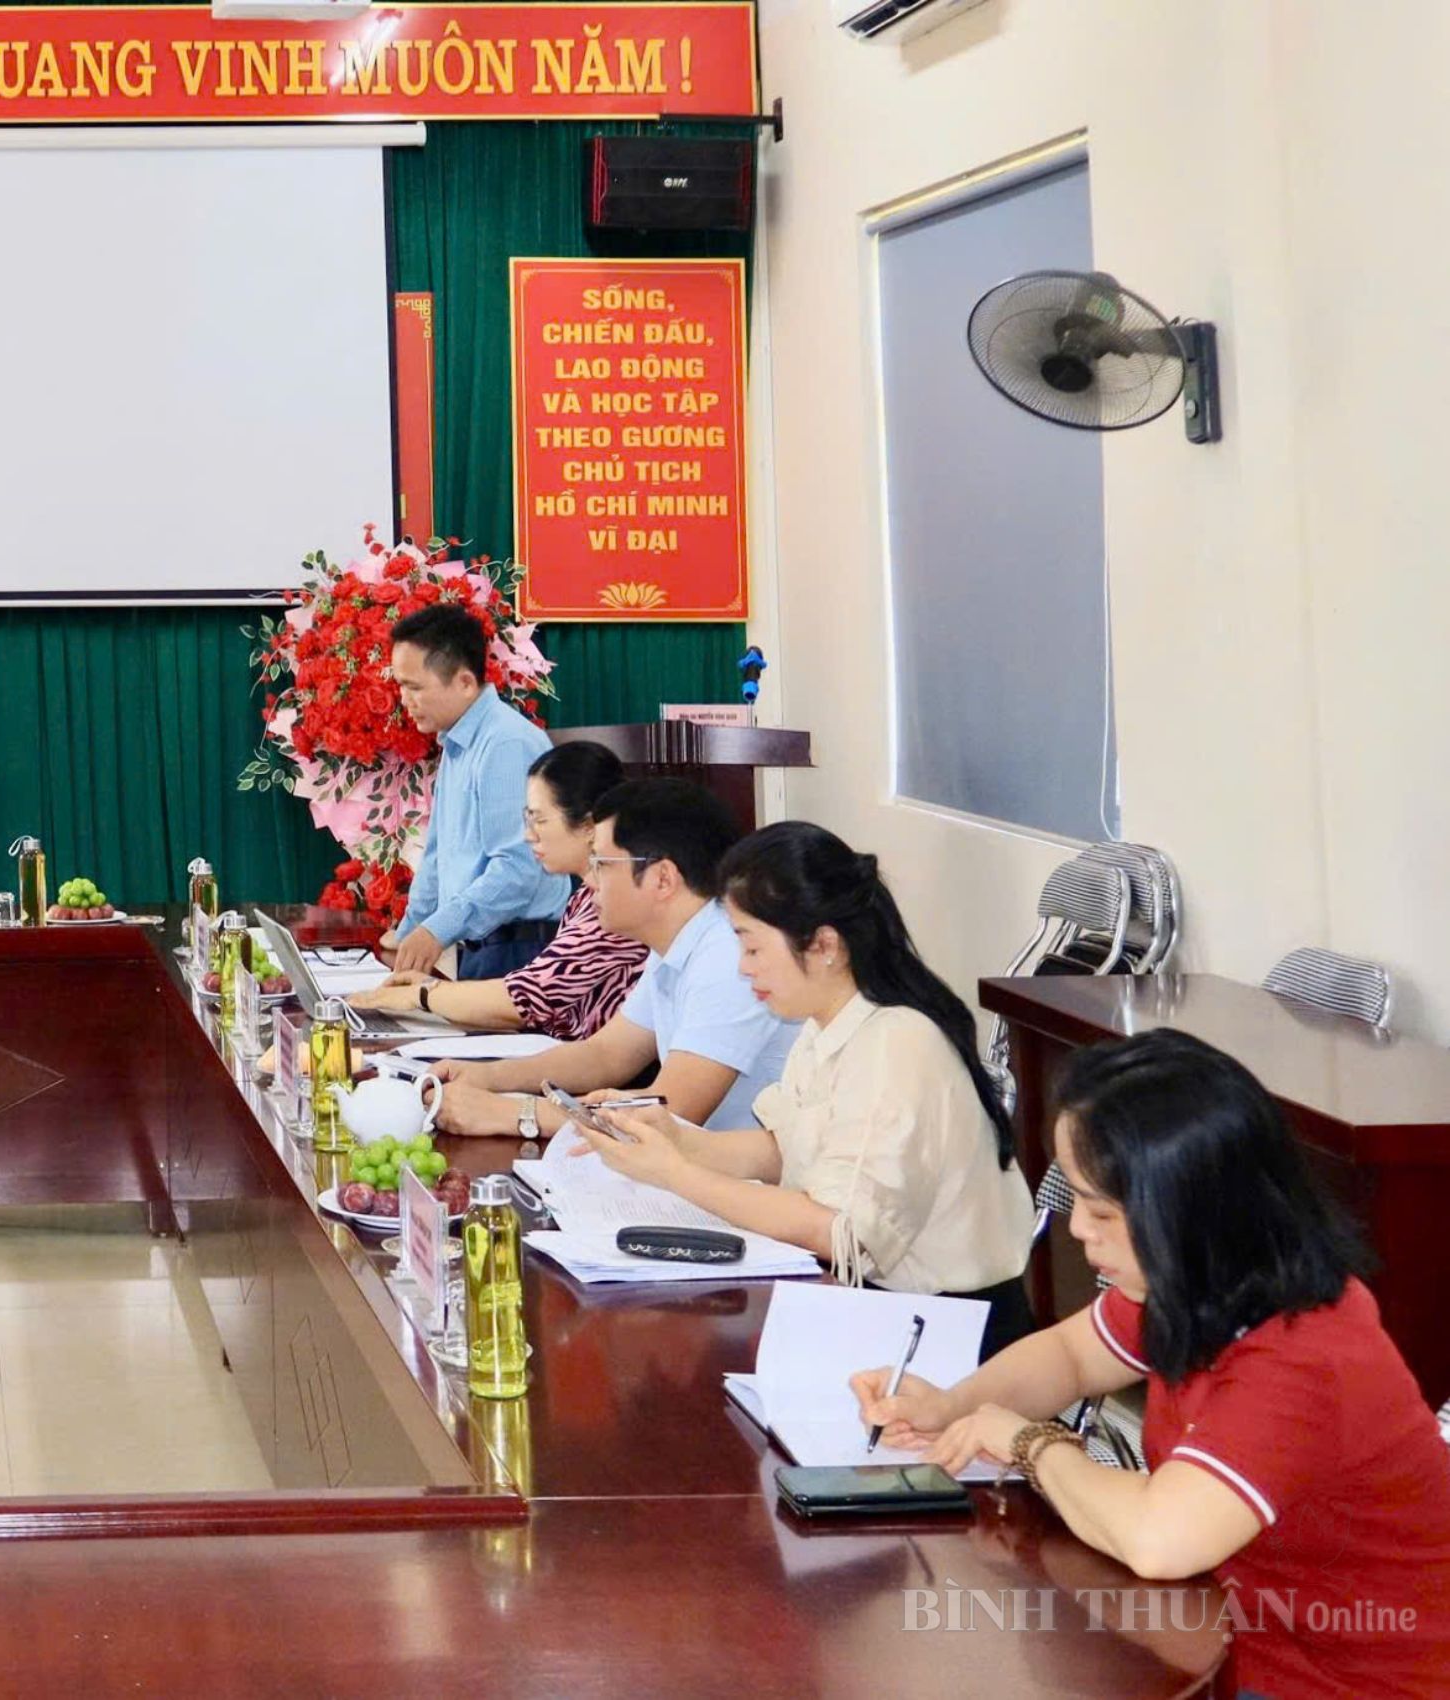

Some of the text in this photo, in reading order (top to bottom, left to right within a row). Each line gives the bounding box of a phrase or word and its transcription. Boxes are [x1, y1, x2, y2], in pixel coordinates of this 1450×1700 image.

[171, 39, 328, 97] VINH
[340, 20, 517, 97] MUÔN
[530, 23, 668, 95] NĂM
[582, 283, 675, 312] SỐNG,
[542, 317, 714, 346] CHIẾN ĐẤU,
[555, 354, 704, 383] LAO ĐỘNG
[541, 387, 719, 418] VÀ HỌC TẬP
[535, 425, 725, 448] THEO GƯƠNG
[563, 454, 701, 485] CHỦ TỊCH
[535, 488, 728, 517] HỒ CHÍ MINH
[588, 525, 678, 554] VĨ ĐẠI
